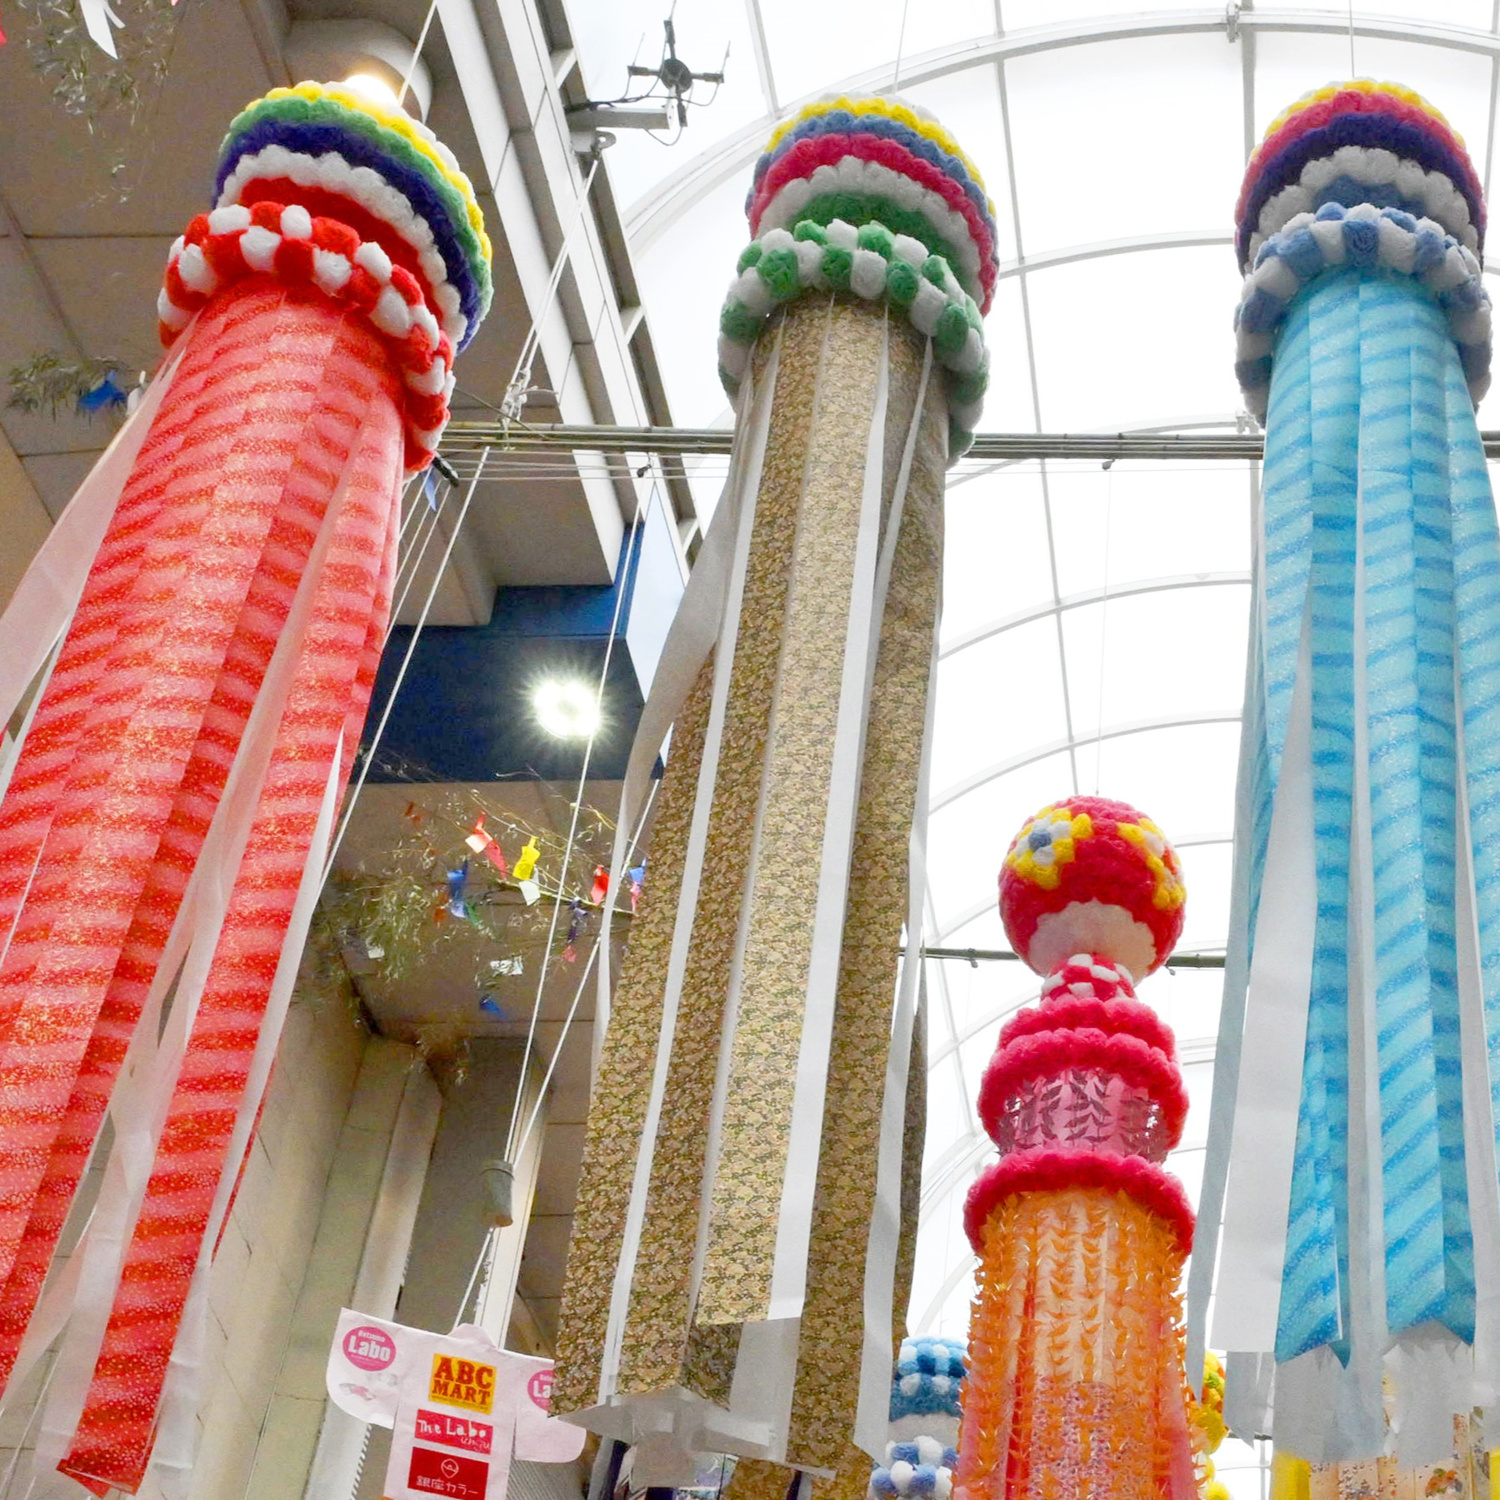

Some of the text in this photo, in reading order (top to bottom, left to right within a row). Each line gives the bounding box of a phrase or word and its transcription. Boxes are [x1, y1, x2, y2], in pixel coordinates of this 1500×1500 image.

[348, 1335, 391, 1362] Labo
[433, 1357, 493, 1389] ABC
[431, 1379, 491, 1405] MART
[417, 1418, 487, 1439] The Labo
[416, 1475, 479, 1496] 銀座カラー
